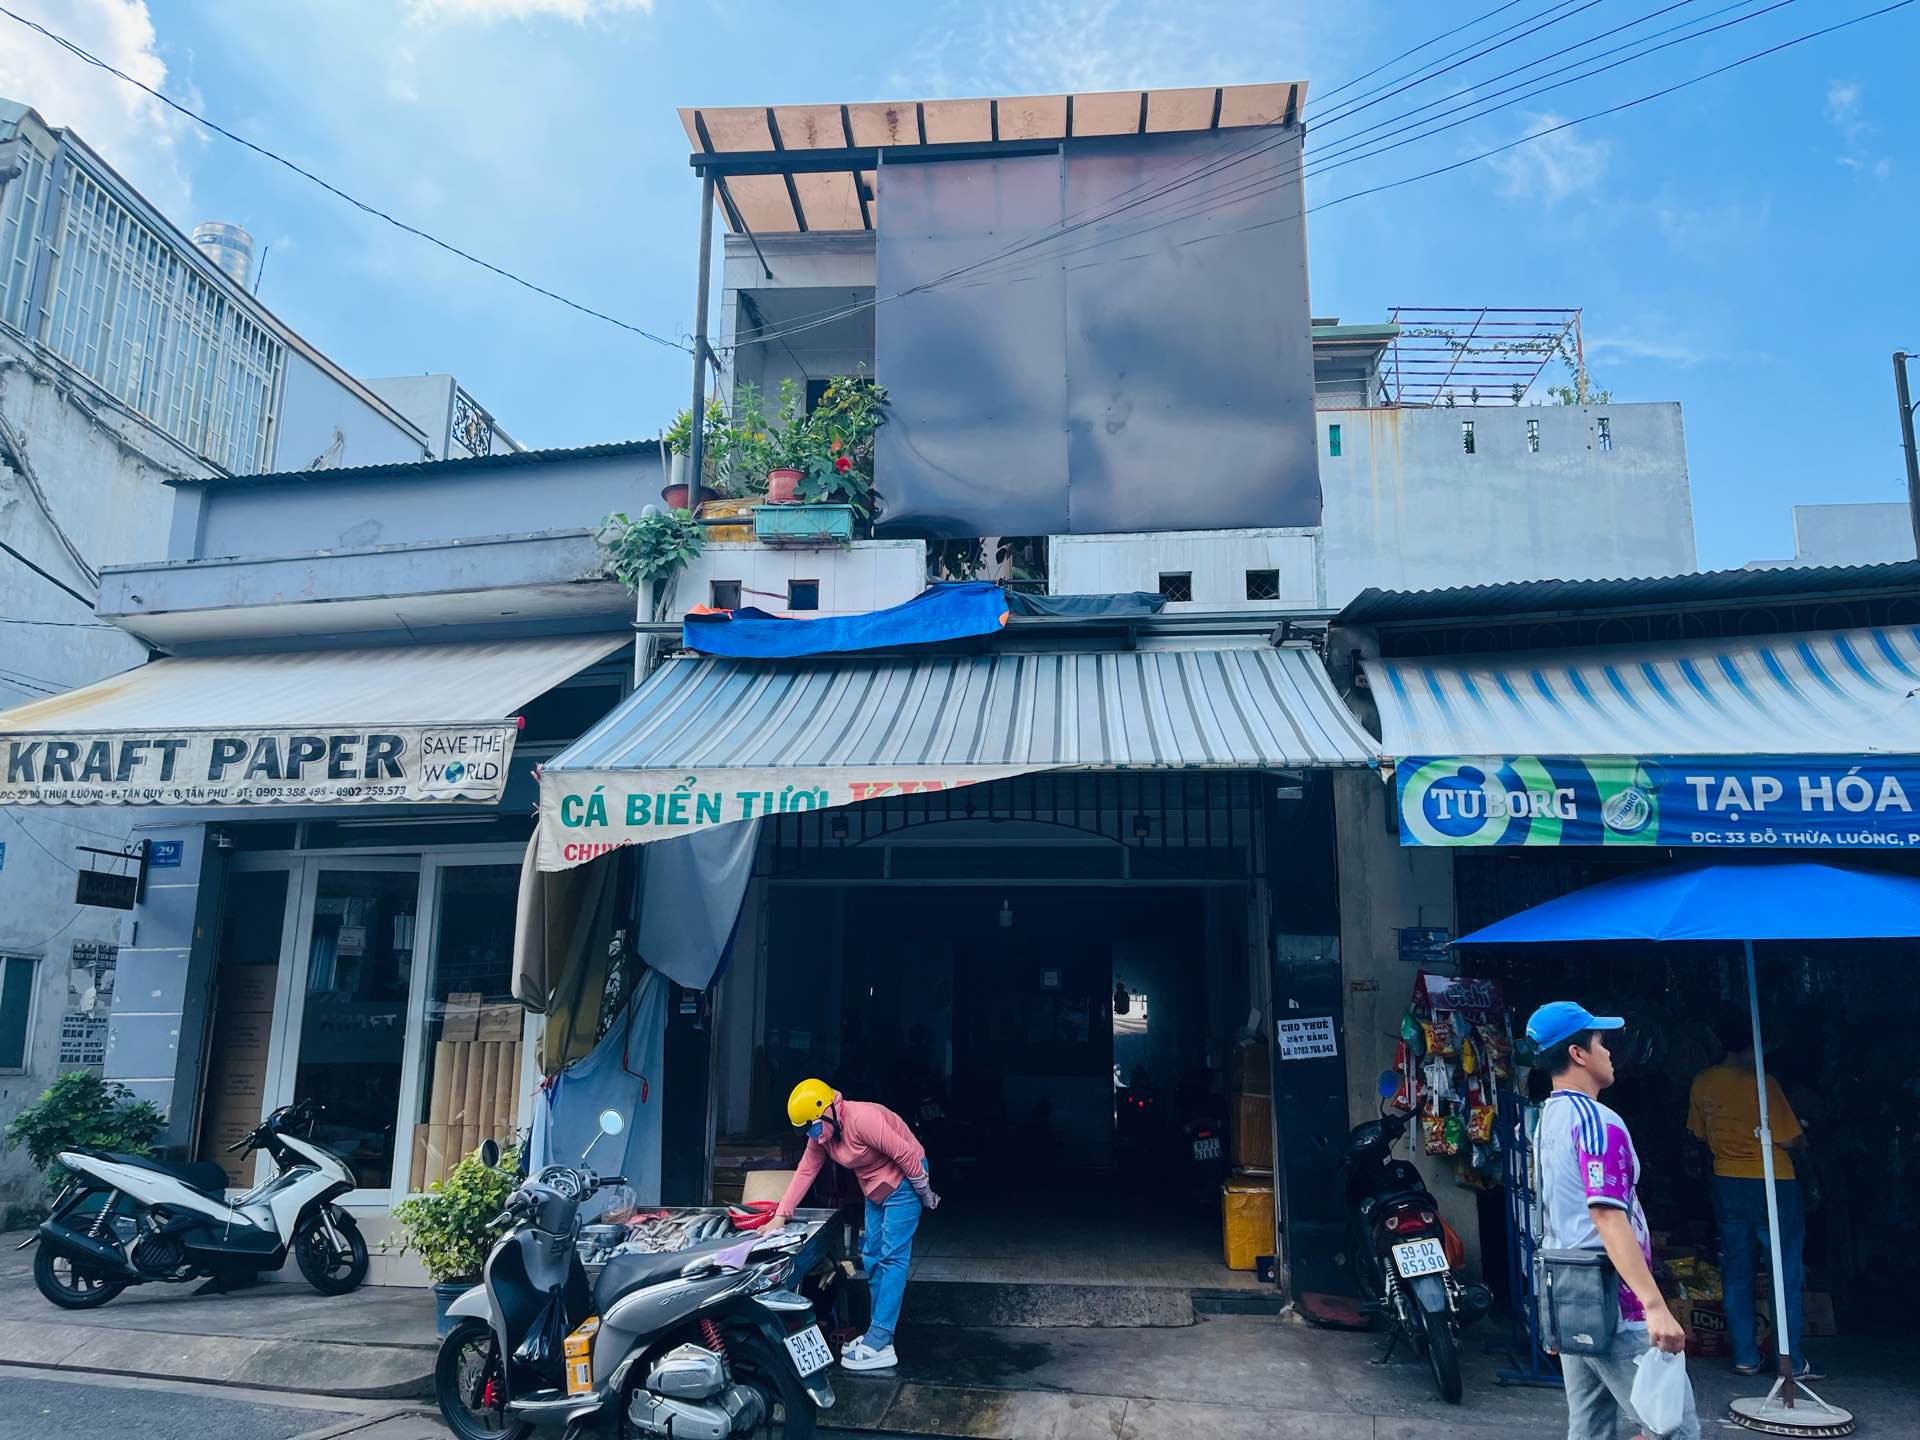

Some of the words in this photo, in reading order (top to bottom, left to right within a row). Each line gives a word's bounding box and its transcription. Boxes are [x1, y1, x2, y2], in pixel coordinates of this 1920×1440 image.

[424, 736, 468, 754] SAVE
[473, 734, 502, 752] THE
[7, 738, 190, 783] KRAFT
[207, 734, 407, 782] PAPER
[111, 789, 120, 799] P.
[123, 786, 141, 799] TÂN
[174, 788, 183, 799] Q.
[185, 785, 204, 798] TÂN
[561, 785, 608, 828] CÁ
[625, 776, 723, 825] BIỂN
[1685, 776, 1783, 821] TẠP
[1799, 767, 1913, 812] HÓA
[1431, 788, 1577, 820] TUBORG
[1609, 792, 1639, 825] TUBORG
[1691, 831, 1721, 844] ĐC:
[1725, 832, 1745, 844] 33
[1750, 827, 1777, 844] ĐỖ
[1782, 830, 1832, 844] THỪA
[157, 844, 175, 857] 29
[1281, 1023, 1300, 1032] CHO
[1401, 1255, 1446, 1275] 853.90
[790, 1330, 819, 1354] 50-N1
